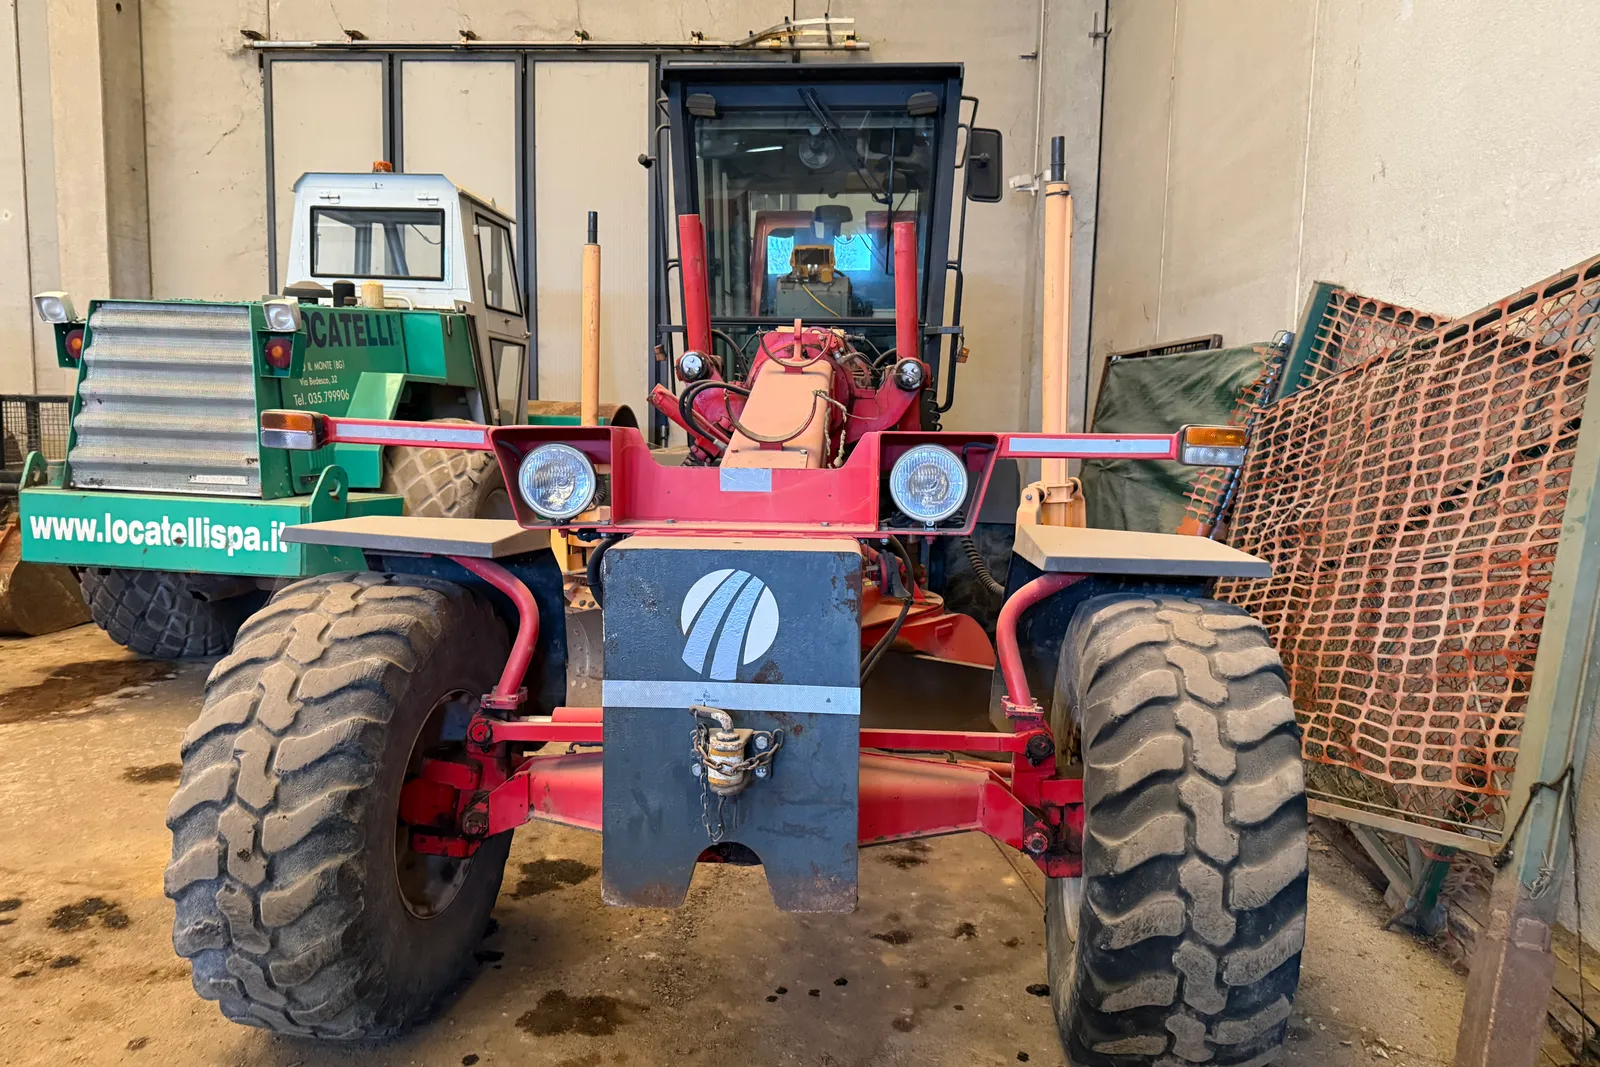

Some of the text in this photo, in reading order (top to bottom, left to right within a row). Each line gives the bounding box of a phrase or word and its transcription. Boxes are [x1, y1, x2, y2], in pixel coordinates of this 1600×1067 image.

[314, 360, 333, 371] MONTE
[334, 358, 345, 371] (BG)
[299, 378, 309, 386] Via
[331, 375, 338, 384] 32
[293, 389, 350, 406] Tel. 035.799906
[29, 512, 288, 556] www.locatellispa.it
